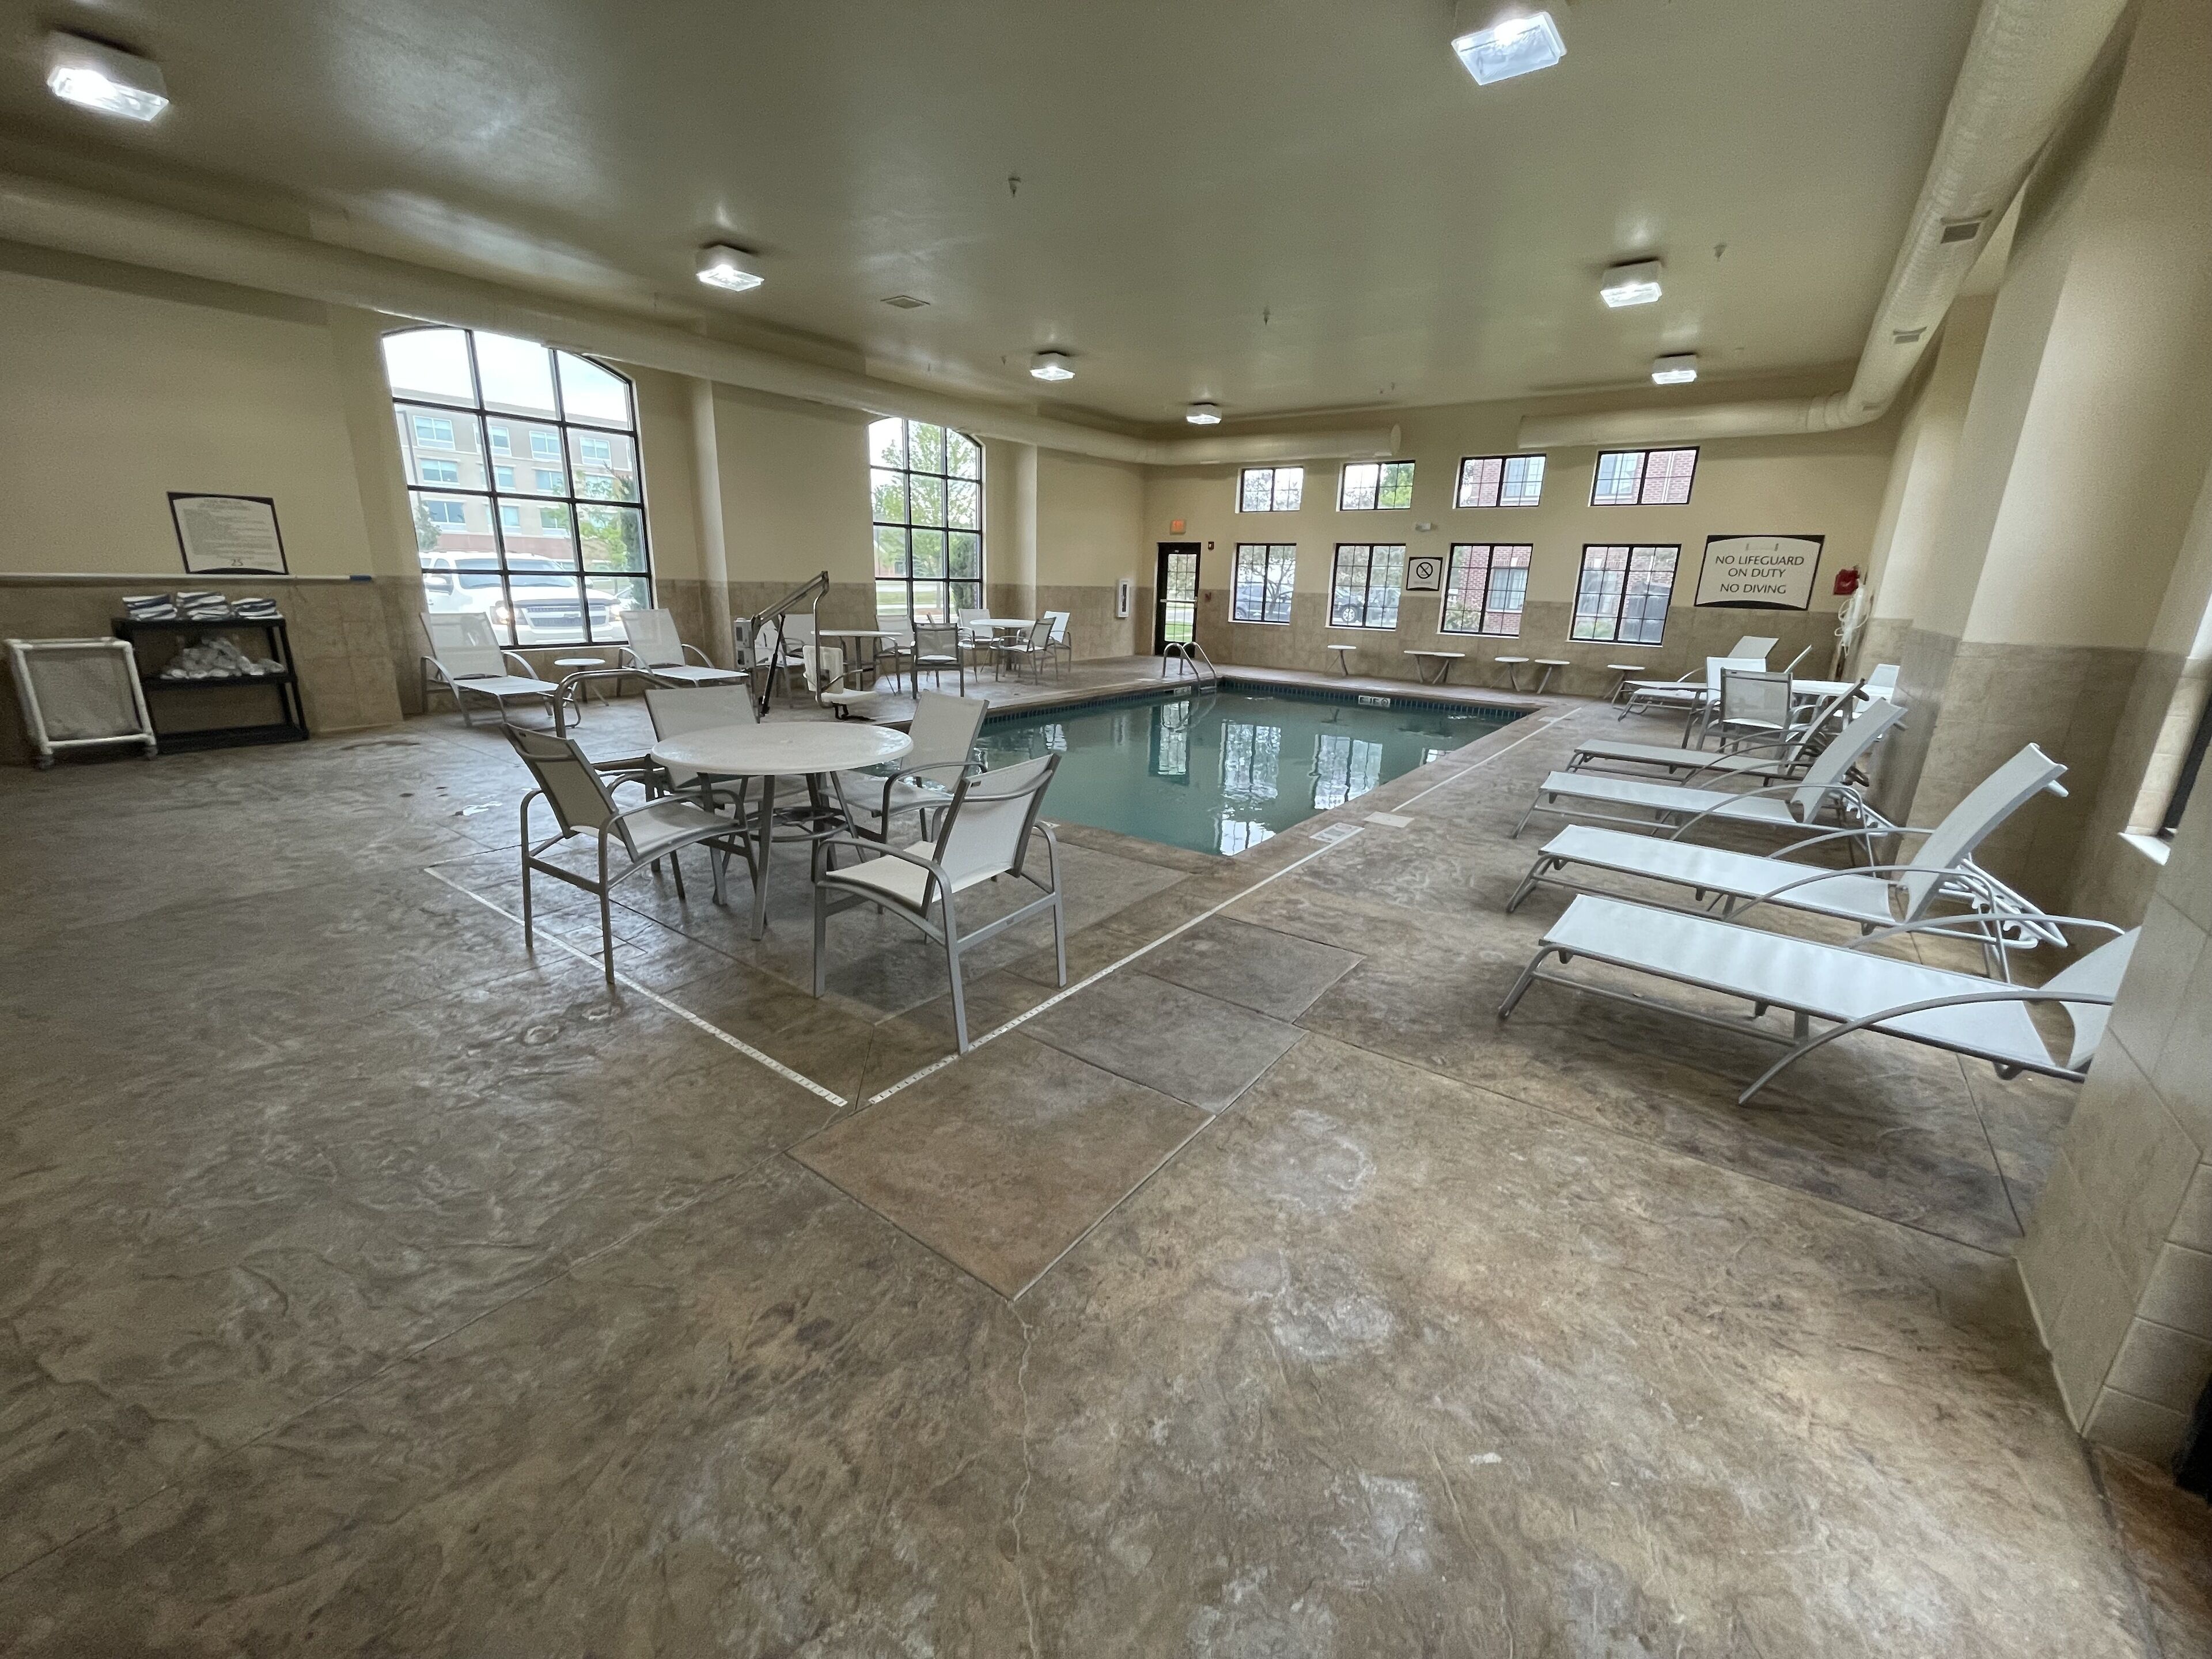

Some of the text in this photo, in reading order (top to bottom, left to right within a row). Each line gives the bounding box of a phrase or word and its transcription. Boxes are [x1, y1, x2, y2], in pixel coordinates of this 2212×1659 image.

[1715, 555, 1805, 566] NO LIFEGUARD
[1728, 567, 1786, 578] ON DUTY
[1720, 584, 1786, 594] NO DIVING
